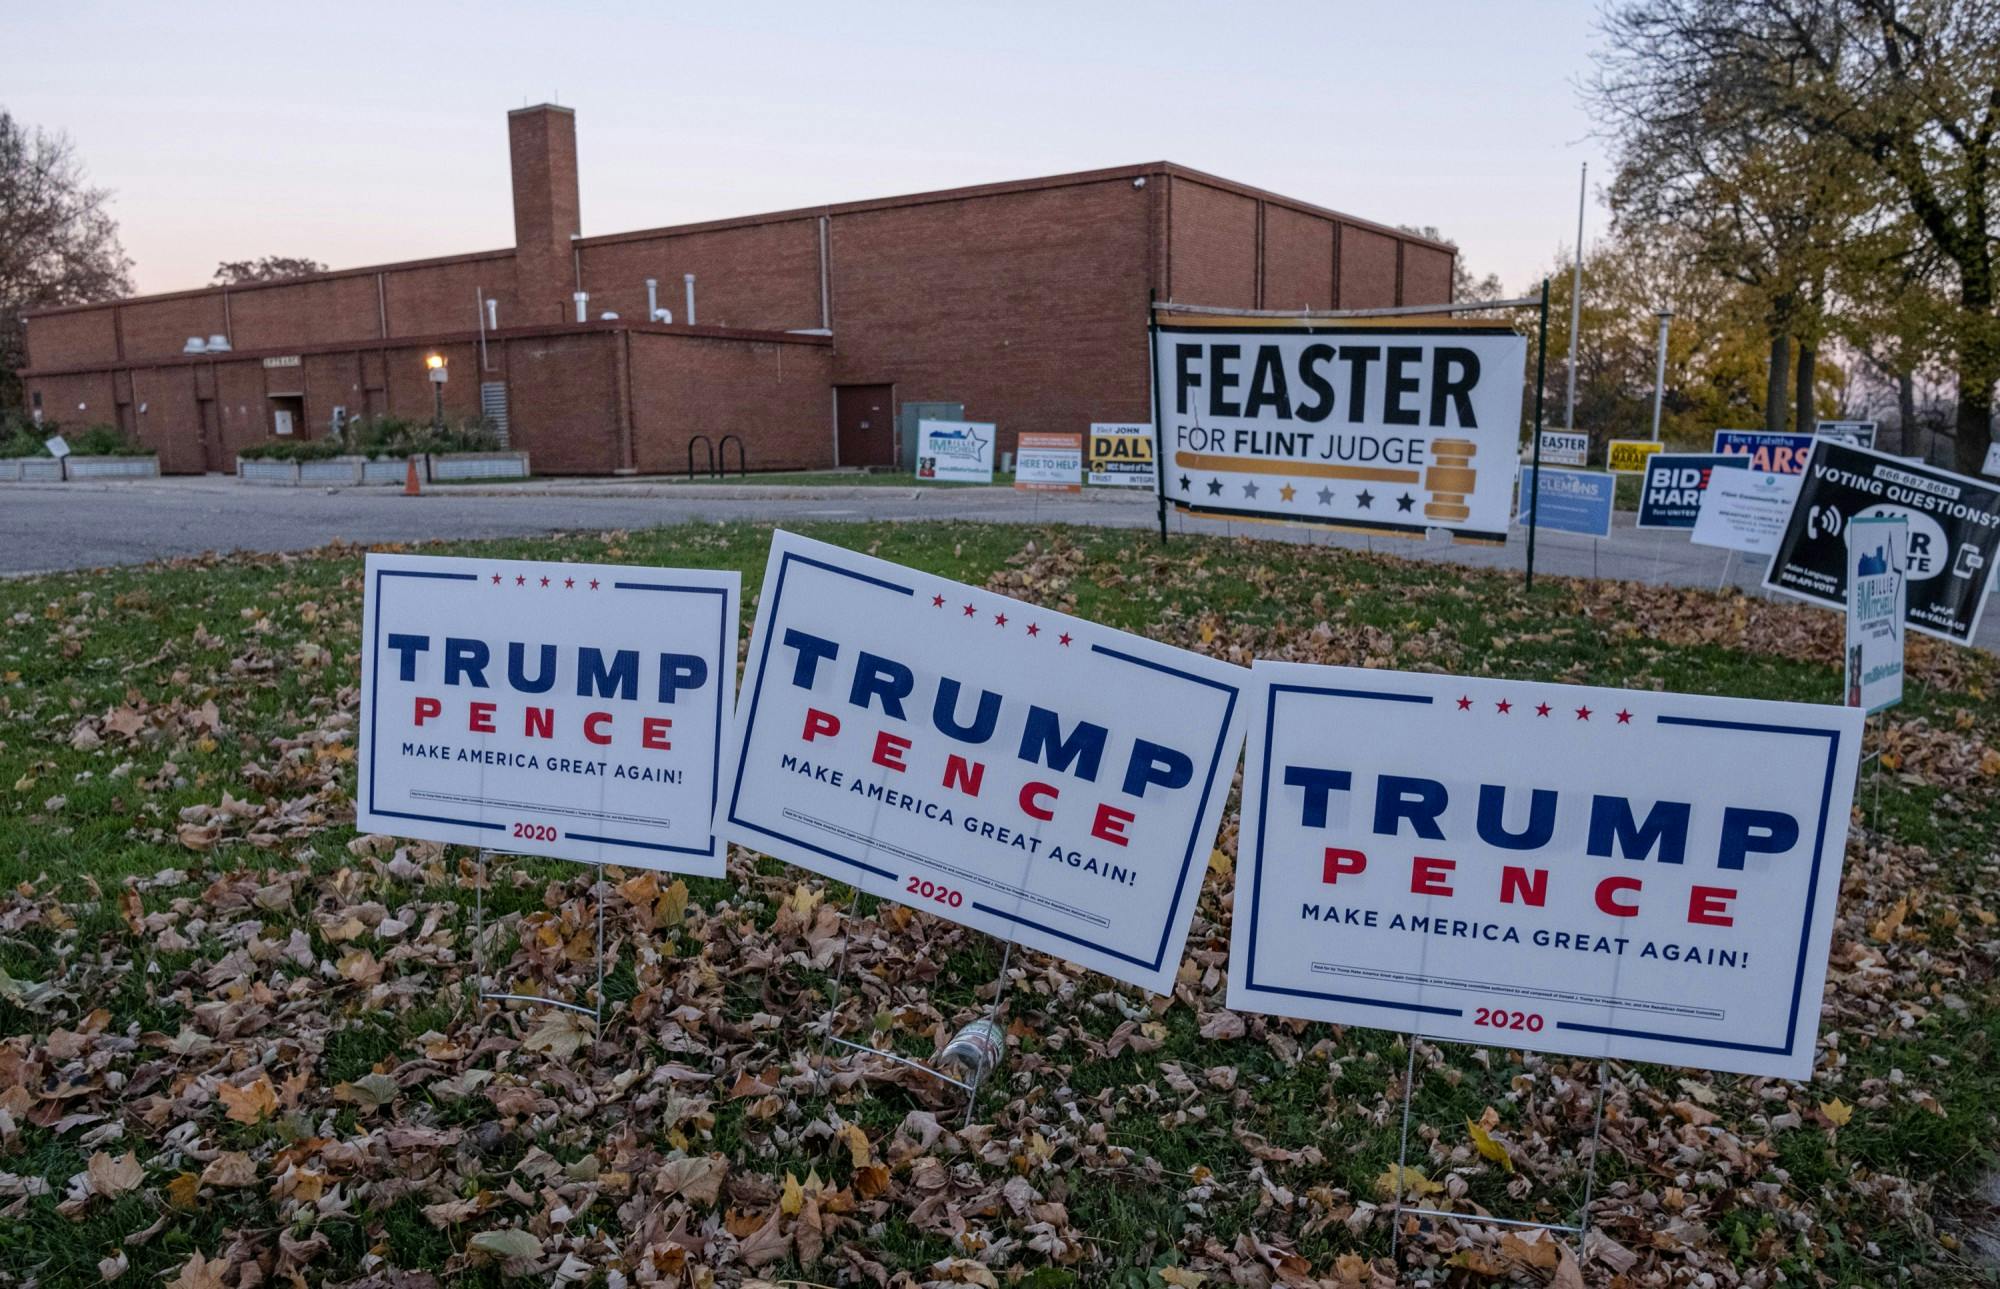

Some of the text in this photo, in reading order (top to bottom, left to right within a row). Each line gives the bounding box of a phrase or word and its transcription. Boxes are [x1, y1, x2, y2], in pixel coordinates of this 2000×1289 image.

[1176, 343, 1481, 428] FEASTER
[1177, 426, 1424, 464] FOR FLINT JUDGE
[1541, 436, 1586, 450] EASTER
[1727, 434, 1794, 447] Elect Tabitha
[1020, 459, 1079, 470] HERE TO HELP
[1722, 444, 1809, 474] ARS
[1651, 467, 1713, 490] BIDE
[1648, 489, 1701, 506] HAR
[1667, 509, 1696, 517] UNITED
[1814, 464, 2000, 529] VOTING QUESTIONS?
[1906, 555, 1931, 573] TE
[1871, 576, 1893, 597] BILLIE
[388, 633, 708, 704] TRUMP
[414, 697, 673, 751] PENCE
[783, 627, 1194, 798] TRUMP
[402, 742, 682, 784] MAKE AMERICA GREAT AGAIN!
[802, 707, 1135, 847] PENCE
[513, 823, 557, 842] 2020
[781, 753, 1137, 887] MAKE AMERICA GREAT AGAIN!
[1284, 765, 1800, 871] TRUMP
[906, 876, 963, 908] 2020
[1322, 847, 1737, 928] PENCE
[1301, 903, 1749, 969] MAKE AMERICA GREAT AGAIN!
[1474, 1007, 1544, 1034] 2020
